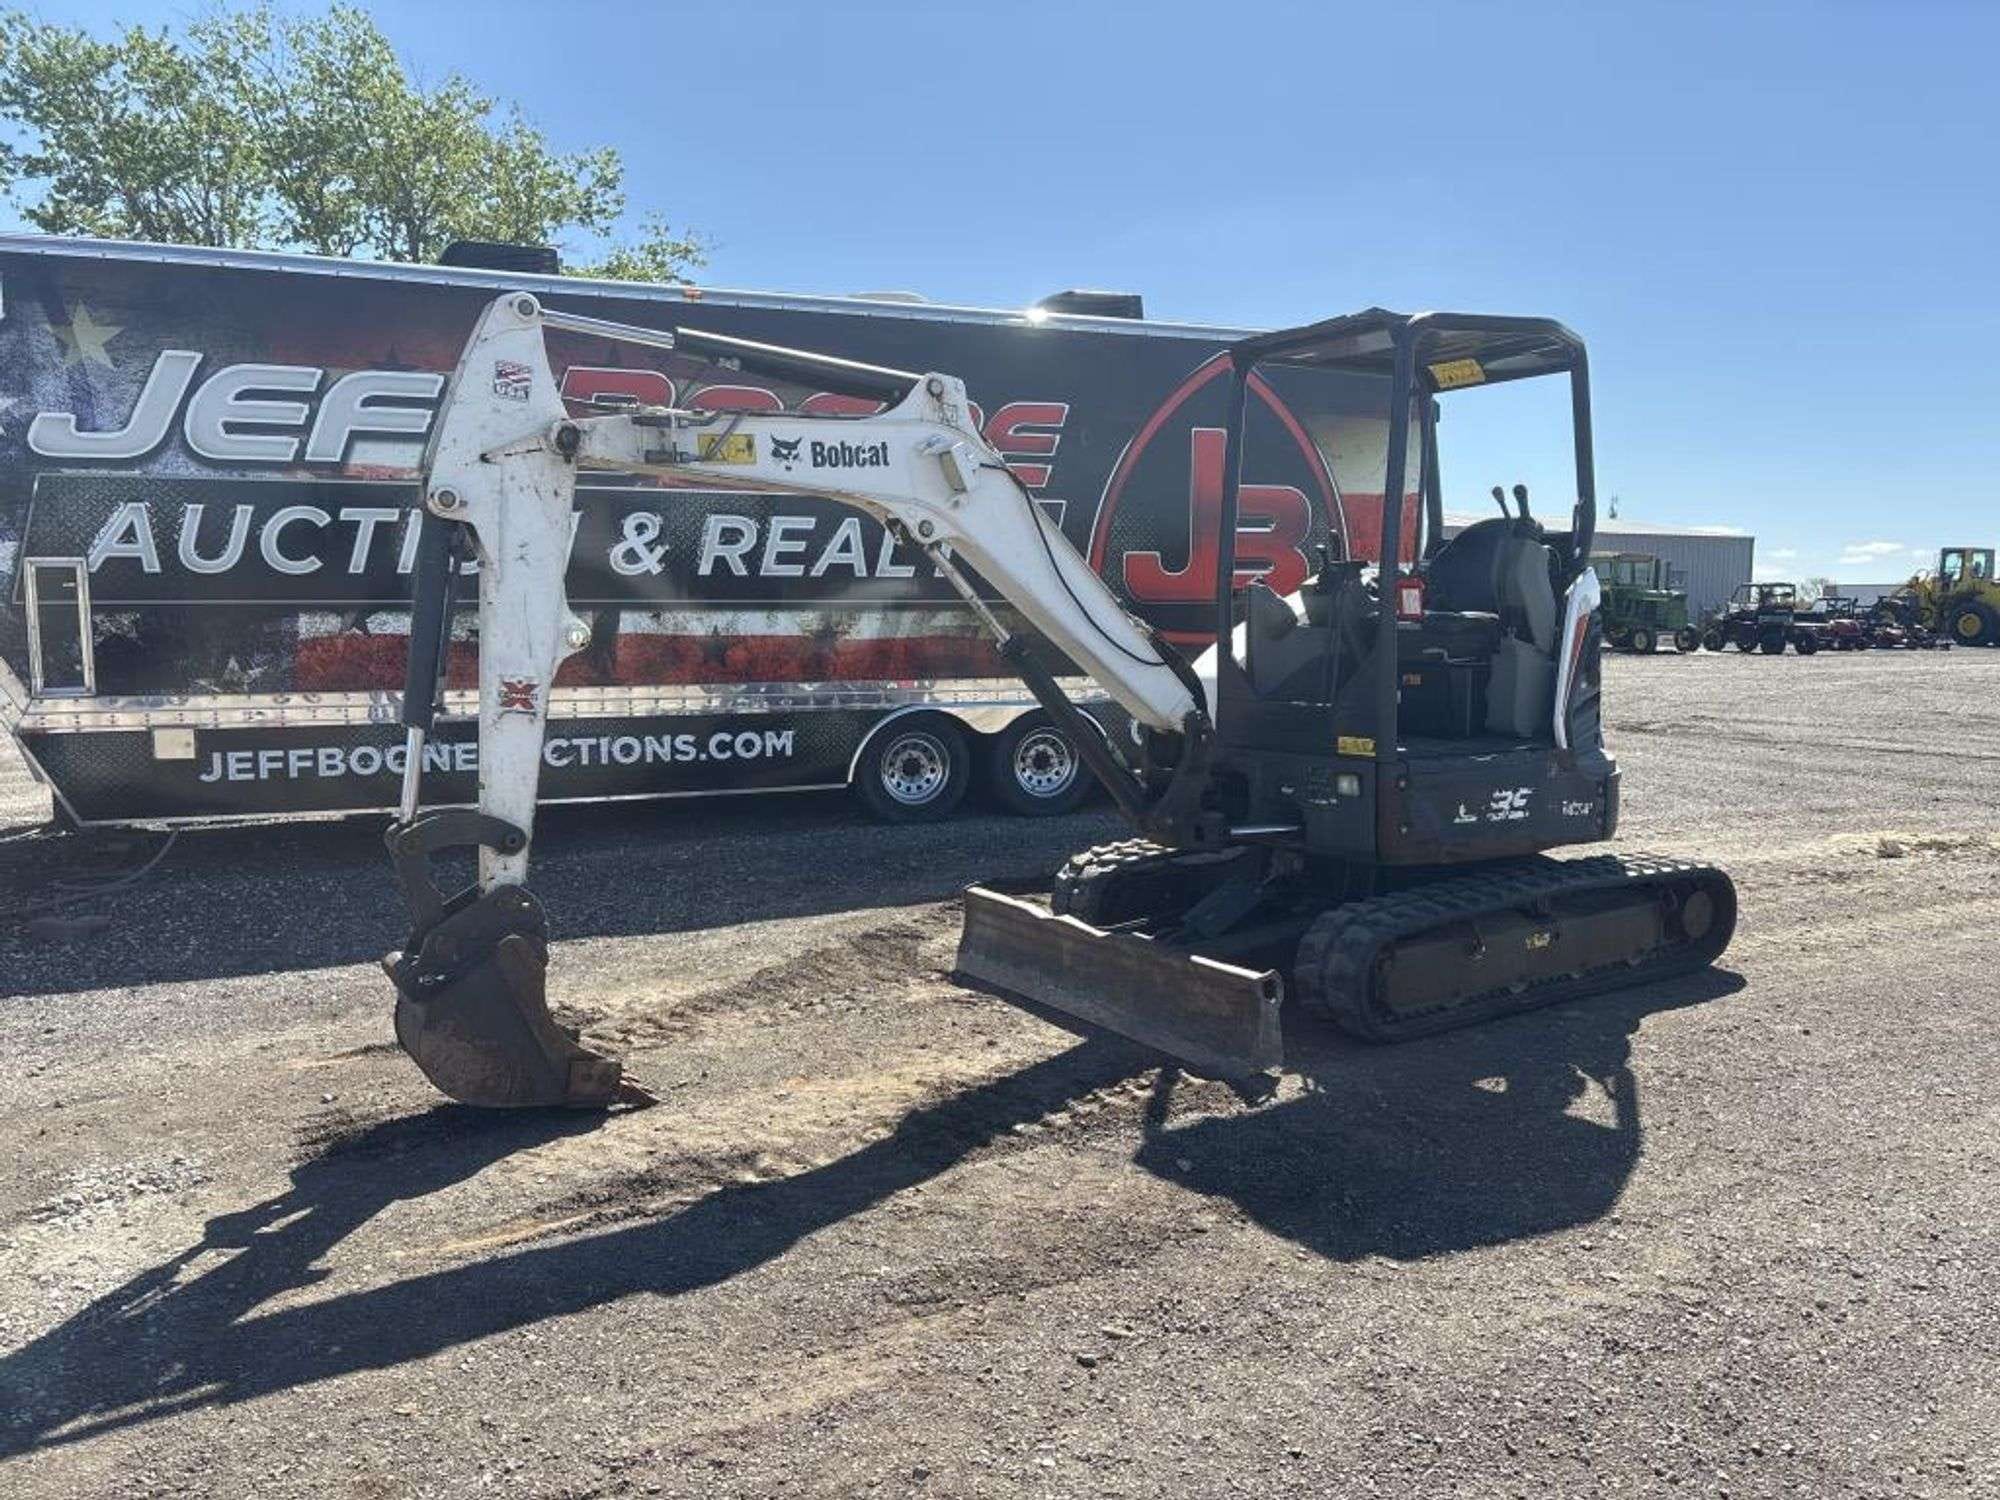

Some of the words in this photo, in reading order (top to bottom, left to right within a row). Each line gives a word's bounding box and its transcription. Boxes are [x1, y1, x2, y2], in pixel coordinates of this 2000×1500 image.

[27, 350, 444, 462] JEF
[810, 439, 891, 469] Bobcat
[609, 512, 668, 576] &
[697, 513, 950, 578] REAL
